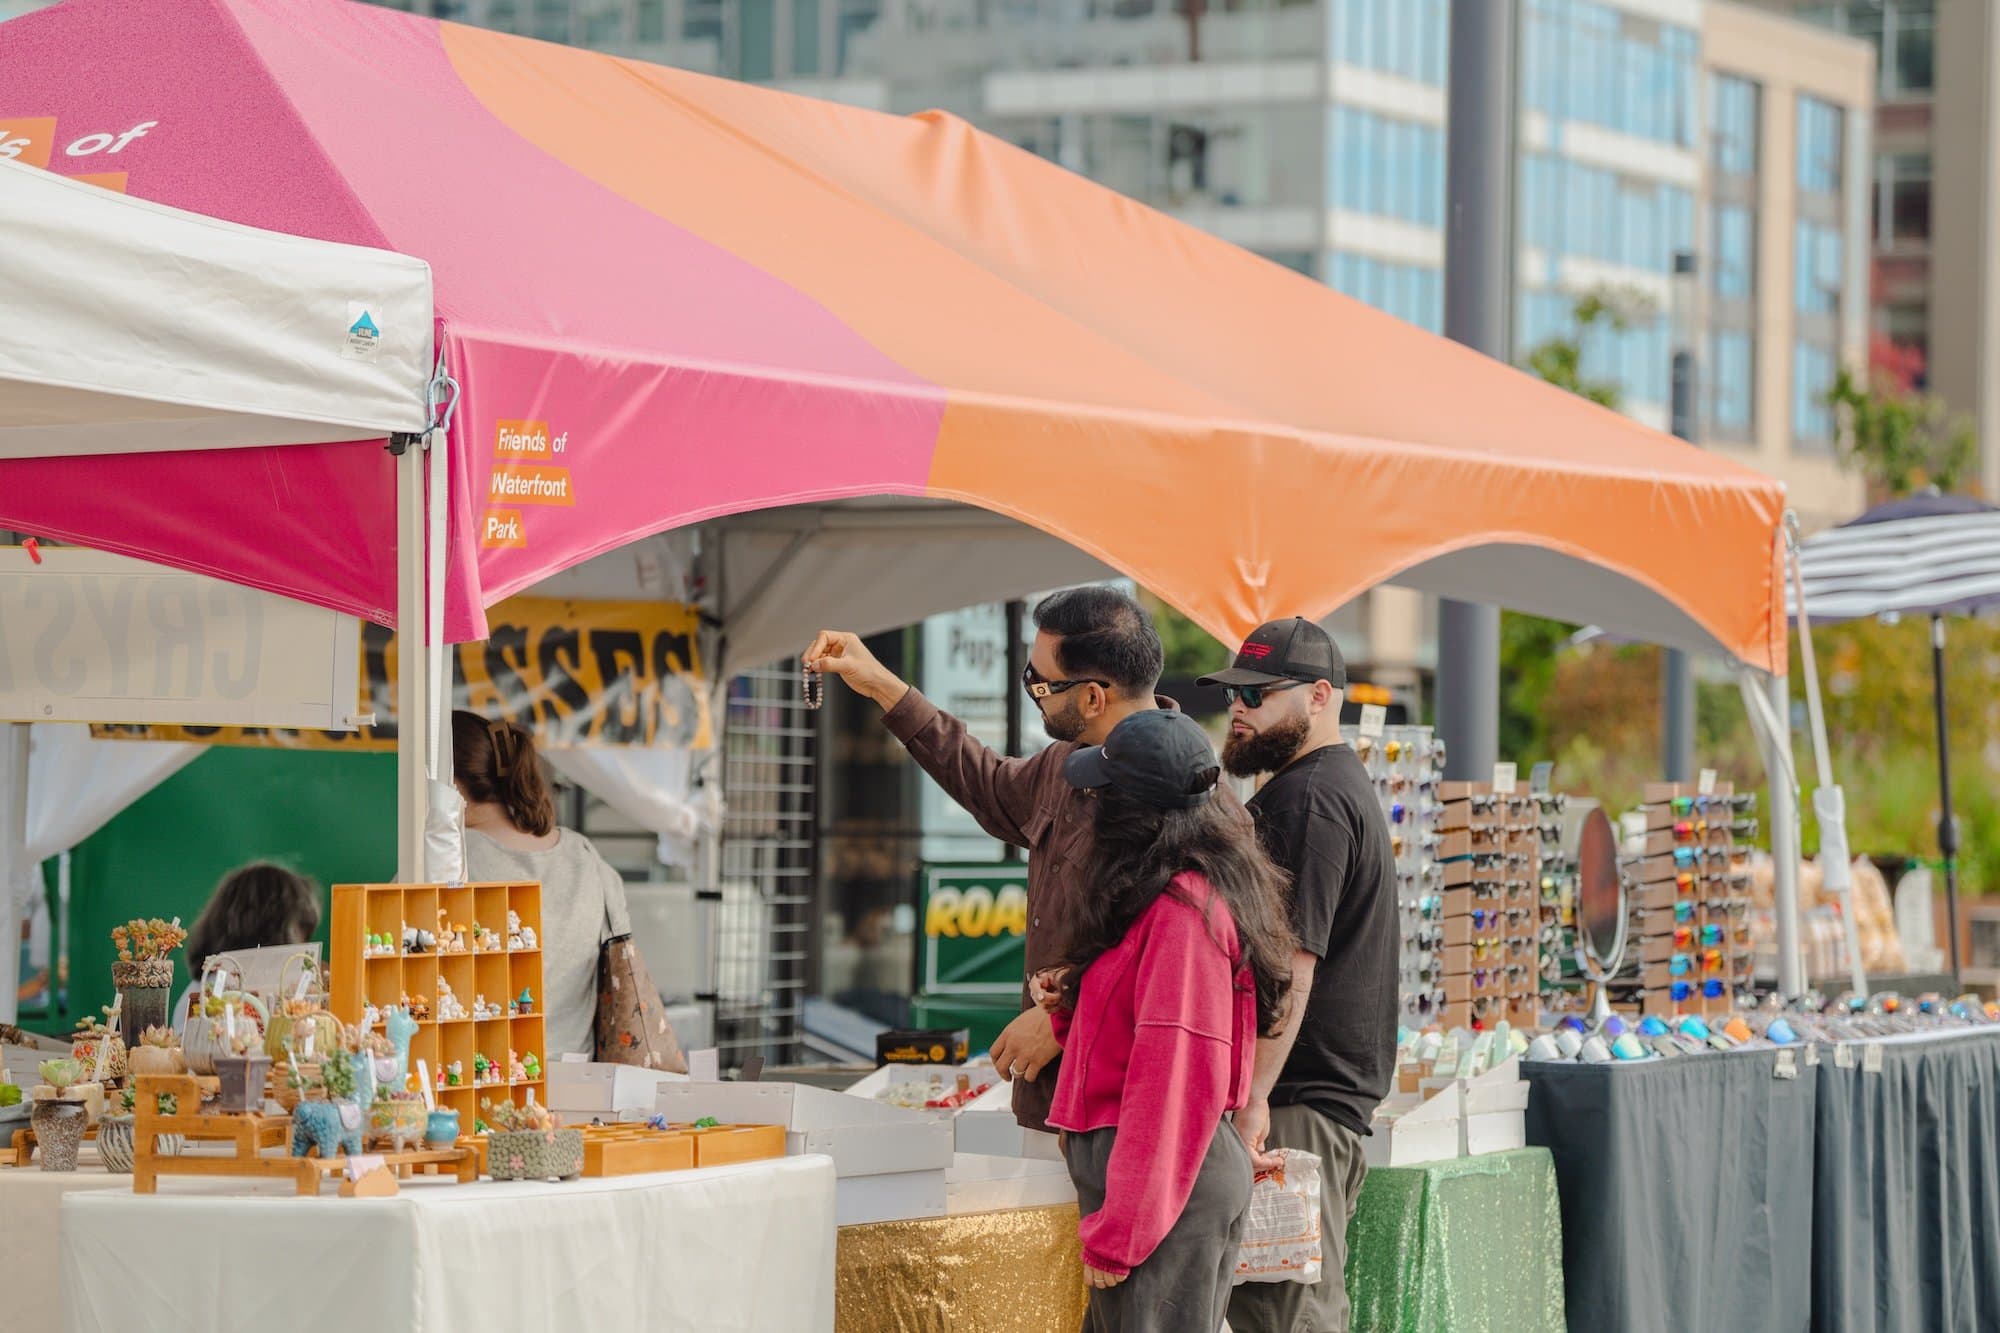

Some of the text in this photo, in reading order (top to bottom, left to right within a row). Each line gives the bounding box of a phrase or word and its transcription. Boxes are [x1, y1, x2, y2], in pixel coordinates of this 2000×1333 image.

[65, 120, 159, 156] of
[498, 427, 568, 453] Friends of
[491, 471, 567, 497] Waterfront
[487, 516, 518, 540] Park
[925, 884, 1027, 938] ROA
